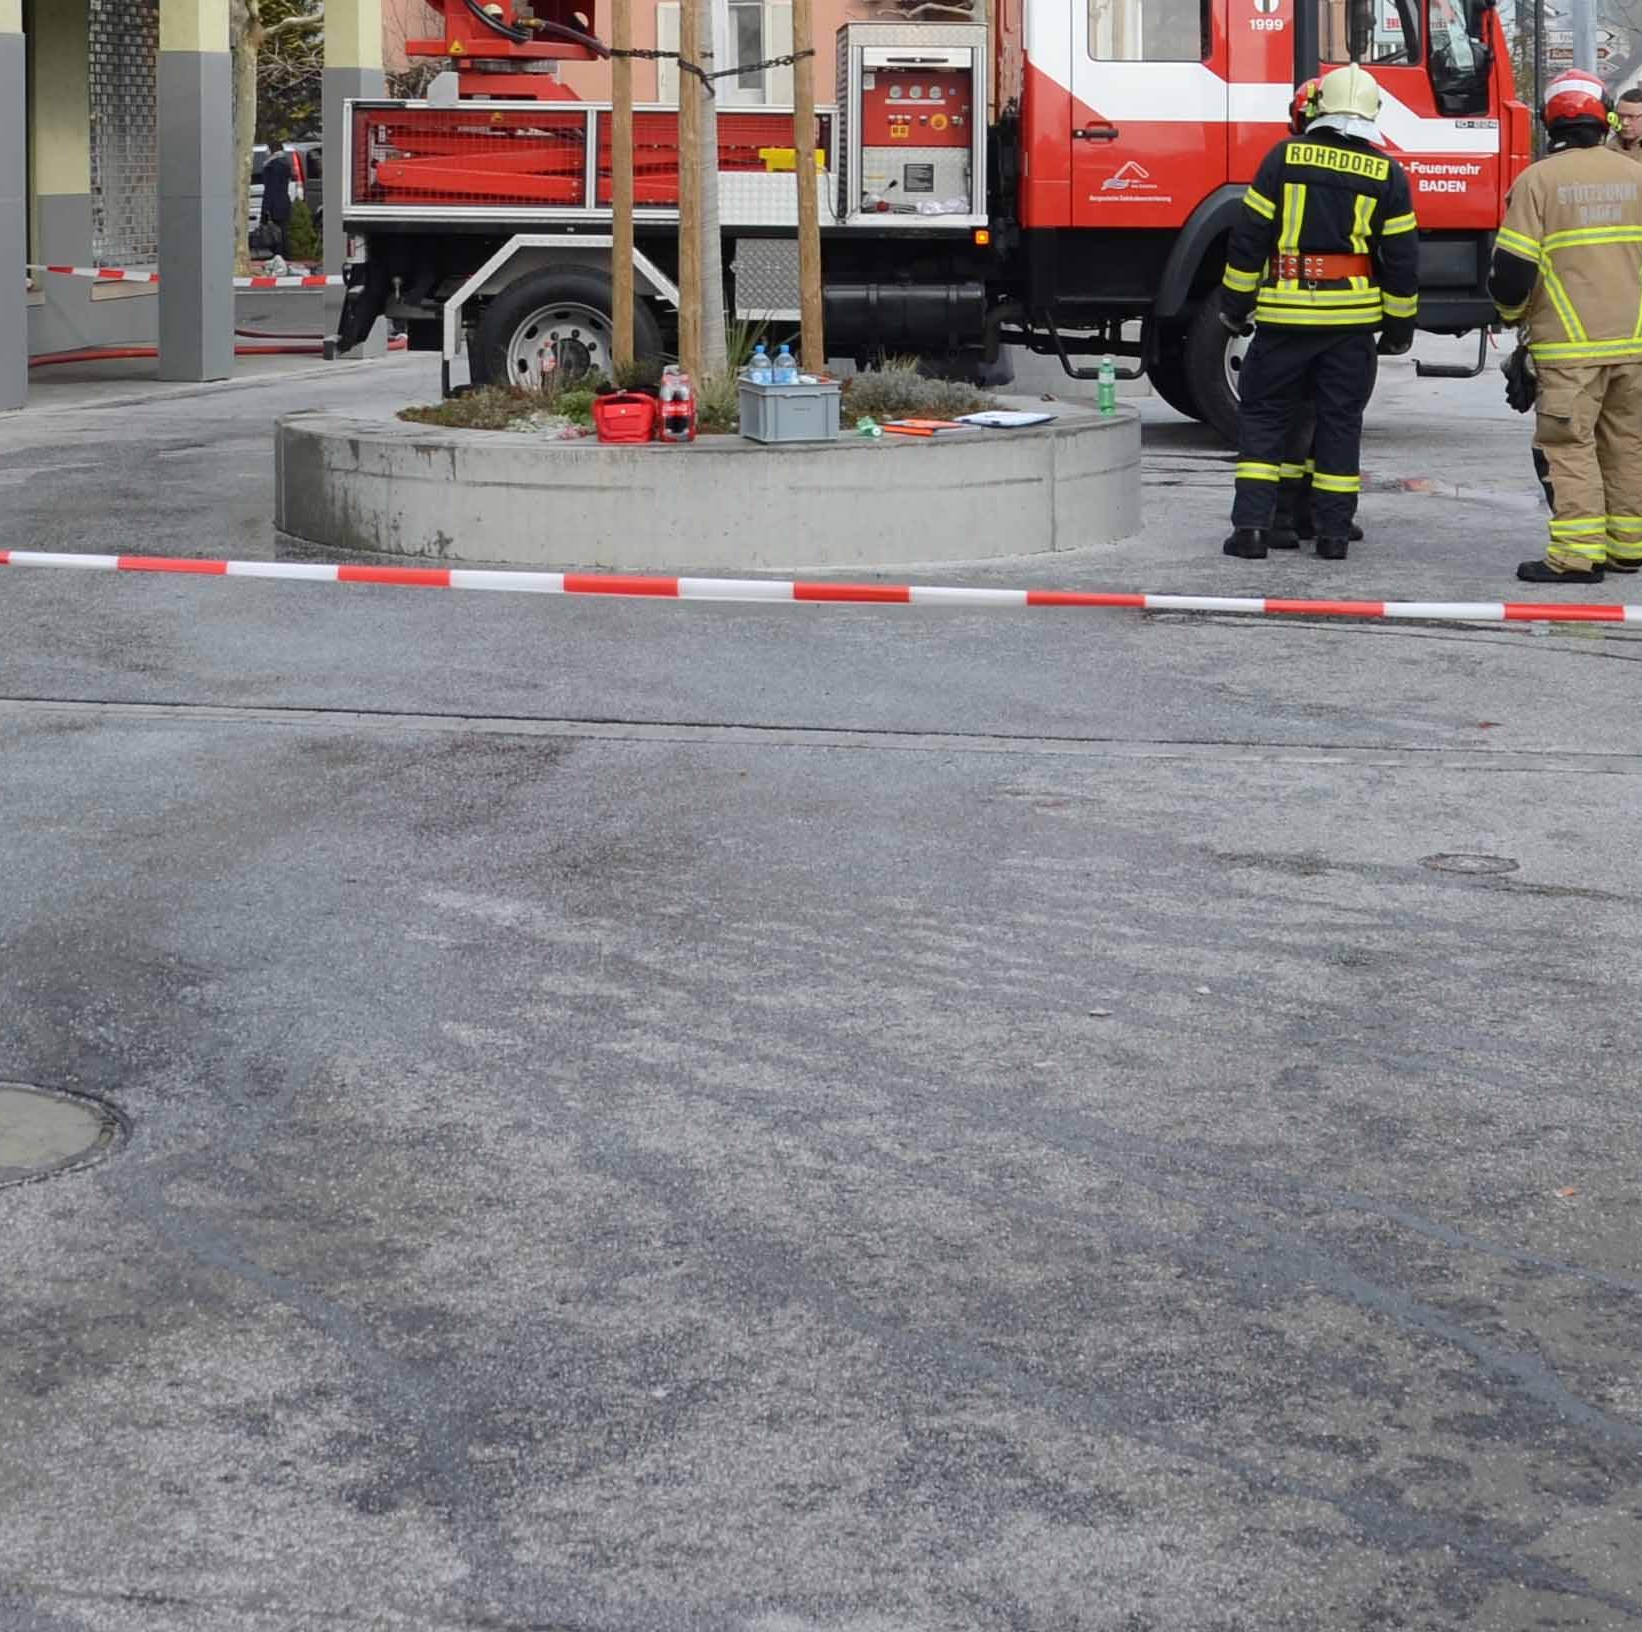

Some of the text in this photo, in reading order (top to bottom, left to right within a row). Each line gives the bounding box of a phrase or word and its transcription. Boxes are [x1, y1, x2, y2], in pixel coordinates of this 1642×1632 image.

[1249, 18, 1284, 31] 1999
[1290, 145, 1385, 178] ROHRDORF
[1400, 161, 1481, 176] -Feuerwehr
[1419, 180, 1467, 193] BADEN
